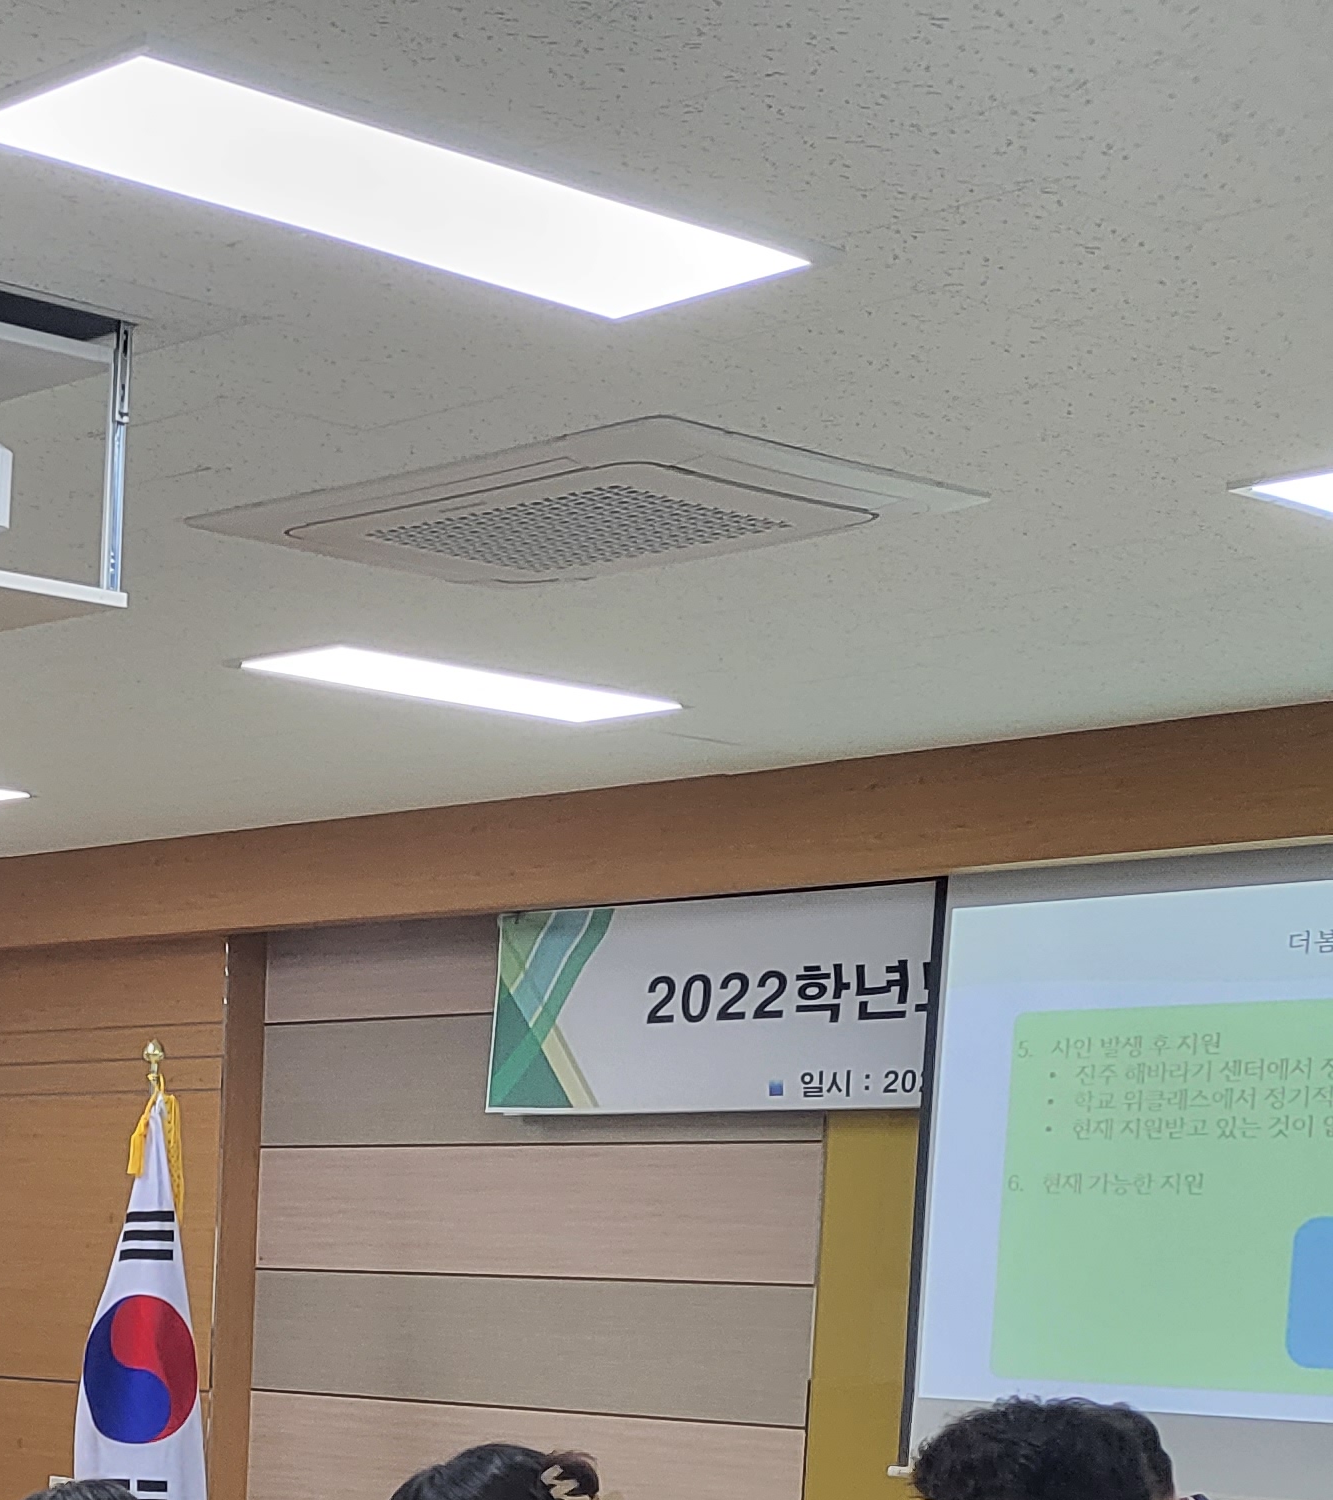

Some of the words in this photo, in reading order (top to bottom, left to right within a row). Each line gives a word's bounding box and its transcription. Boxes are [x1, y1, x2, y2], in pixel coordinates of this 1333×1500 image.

[1100, 1035, 1143, 1058] 발생
[1152, 1033, 1171, 1056] 후
[1177, 1031, 1222, 1056] 지원
[800, 1069, 852, 1098] 일시
[1075, 1062, 1118, 1087] 진주
[1124, 1060, 1214, 1085] 해바라기
[1219, 1056, 1312, 1083] 센터에서
[1075, 1089, 1118, 1113] 학교
[1123, 1085, 1255, 1113] 위클래스에서
[1073, 1117, 1114, 1140] 현재
[1120, 1116, 1209, 1140] 지원받고
[1216, 1115, 1262, 1140] 있는
[1268, 1114, 1314, 1139] 것이
[1007, 1174, 1025, 1193] 6.
[1043, 1172, 1083, 1196] 현재
[1088, 1172, 1155, 1196] 가능한
[1160, 1172, 1205, 1196] 지원
